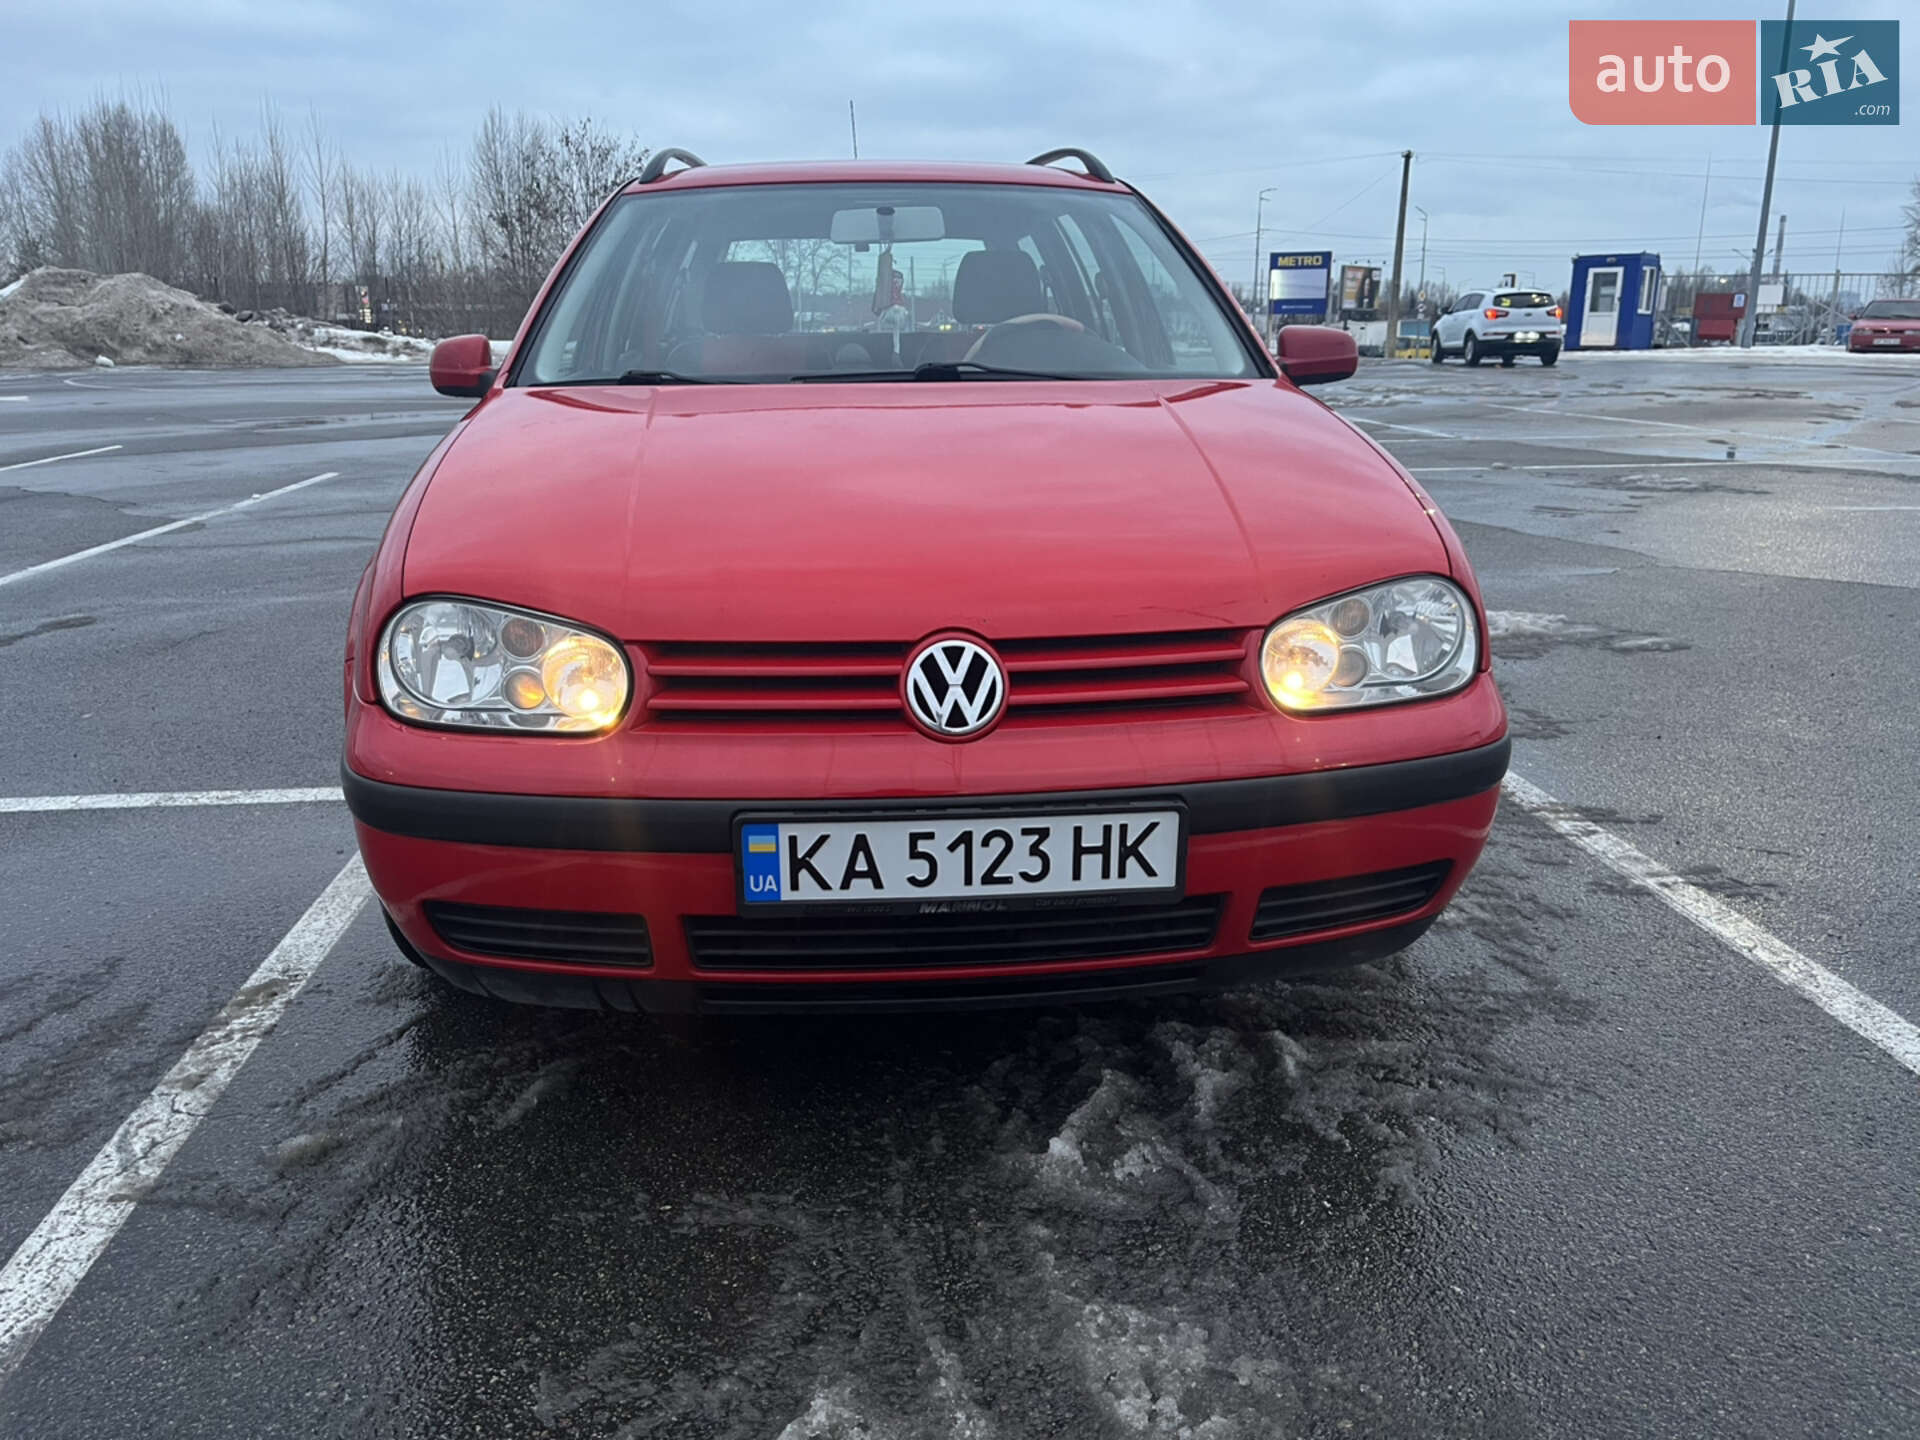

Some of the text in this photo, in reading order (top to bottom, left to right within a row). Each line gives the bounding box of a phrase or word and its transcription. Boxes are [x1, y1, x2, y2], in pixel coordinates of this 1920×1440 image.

[1278, 255, 1323, 267] METRO
[788, 821, 1161, 892] KA 5123 HK
[749, 874, 778, 893] UA
